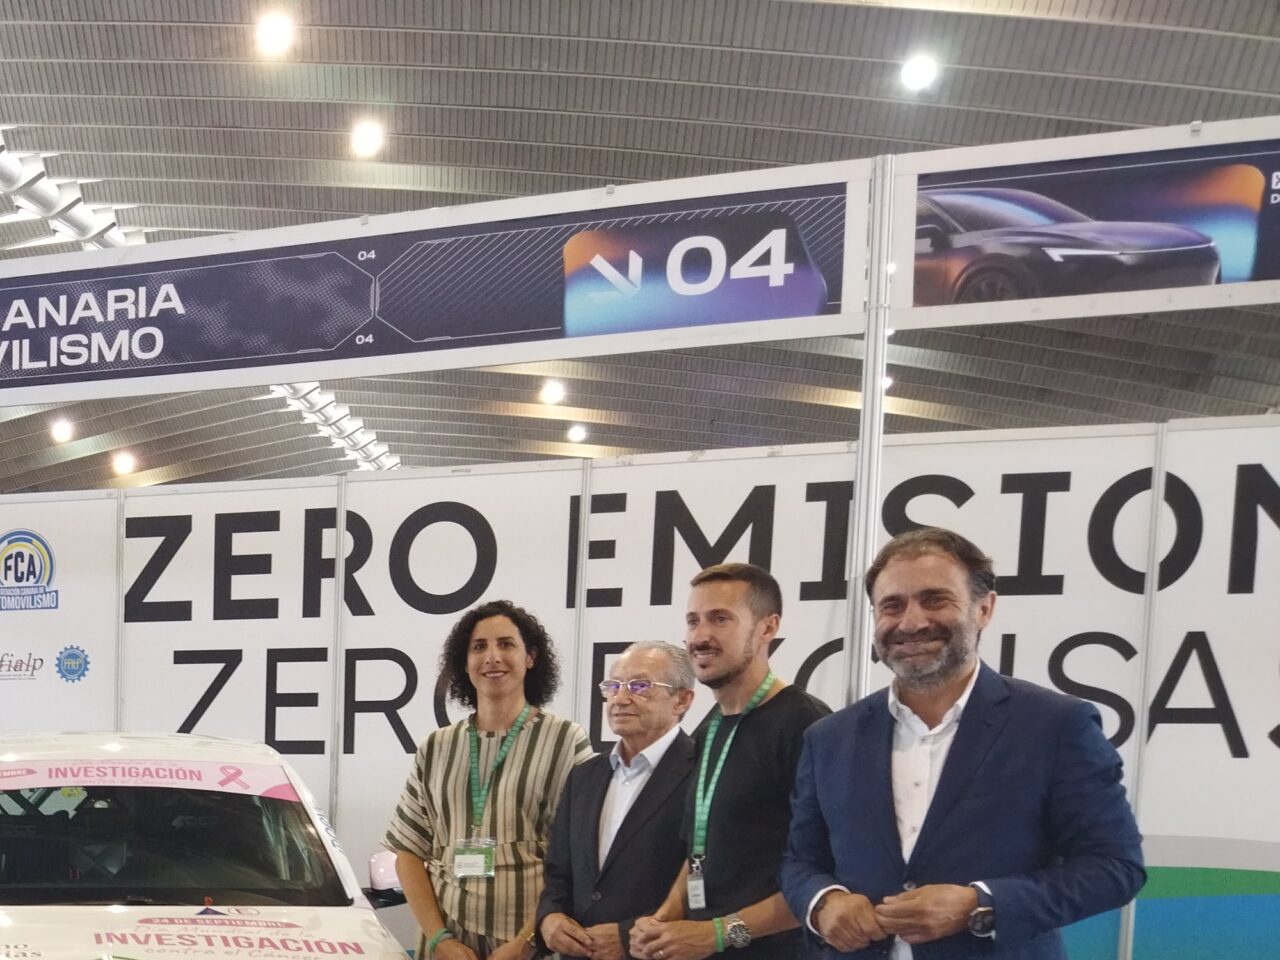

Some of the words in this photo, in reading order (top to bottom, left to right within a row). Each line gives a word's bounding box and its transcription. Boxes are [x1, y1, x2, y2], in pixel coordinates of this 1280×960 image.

[357, 250, 376, 261] 04
[666, 228, 794, 296] 04
[355, 334, 374, 345] 04
[3, 551, 37, 583] FCA
[124, 500, 498, 623] ZERO
[48, 765, 203, 782] INVESTIGACIÓN
[94, 931, 365, 956] INVESTIGACIÓN
